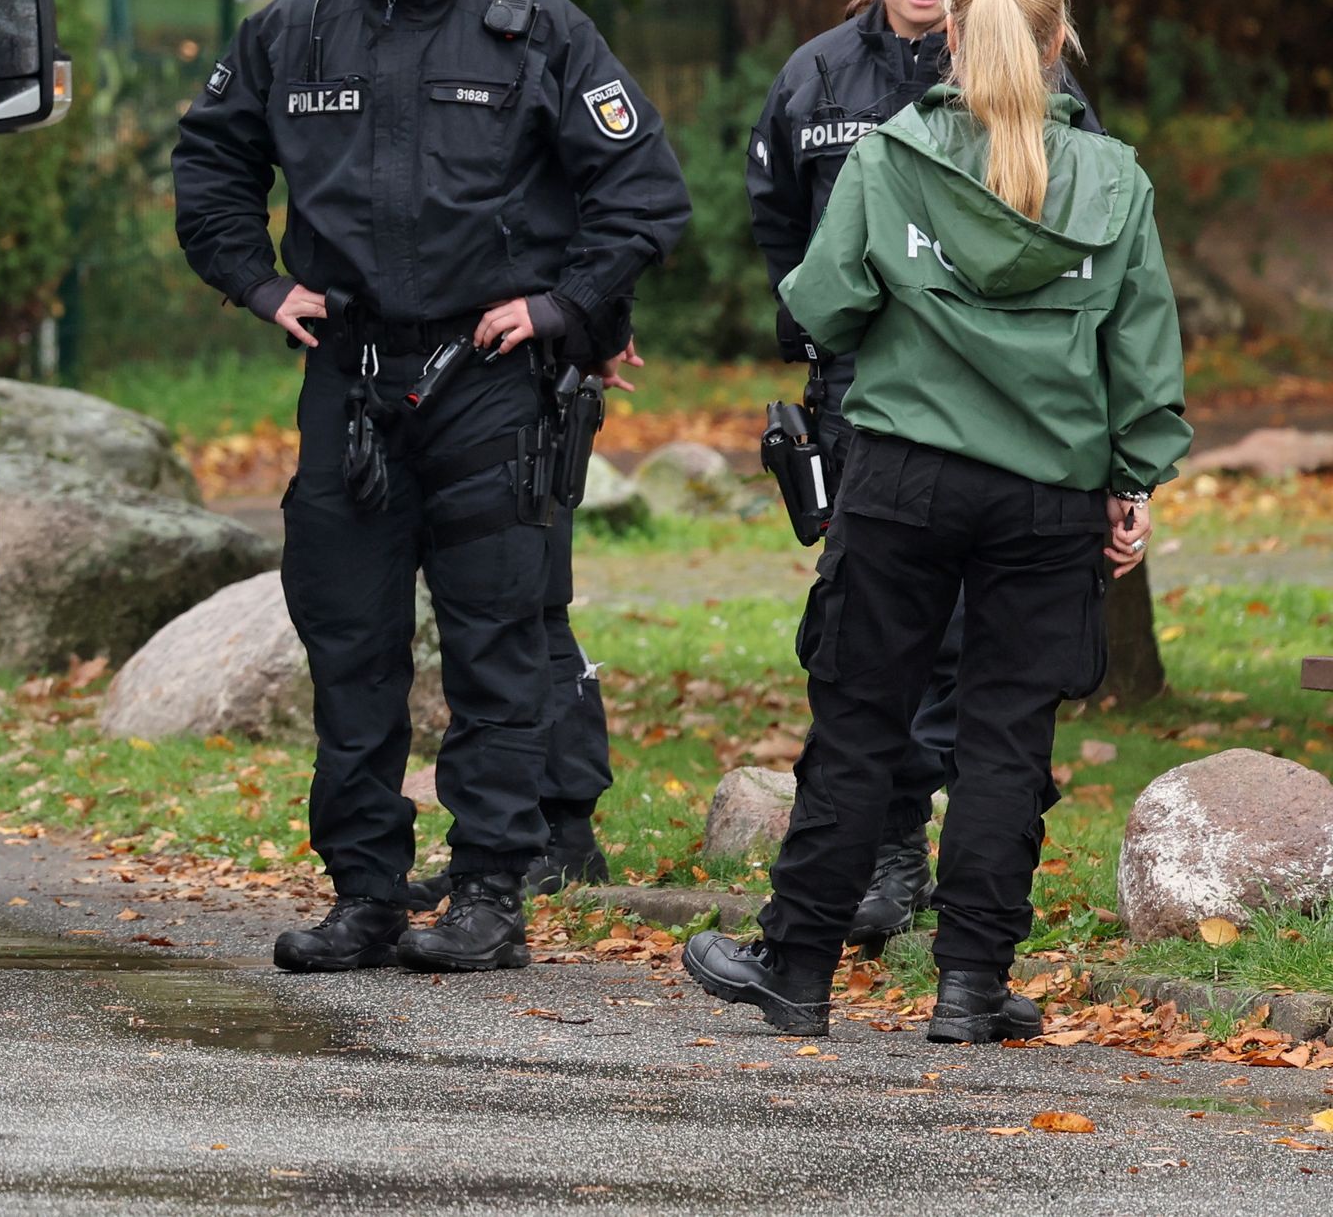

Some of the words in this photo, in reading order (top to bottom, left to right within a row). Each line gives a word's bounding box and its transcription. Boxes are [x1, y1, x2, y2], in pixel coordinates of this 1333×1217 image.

[288, 89, 360, 114] POLIZEI
[456, 87, 490, 103] 31626
[587, 84, 623, 106] POLIZEI
